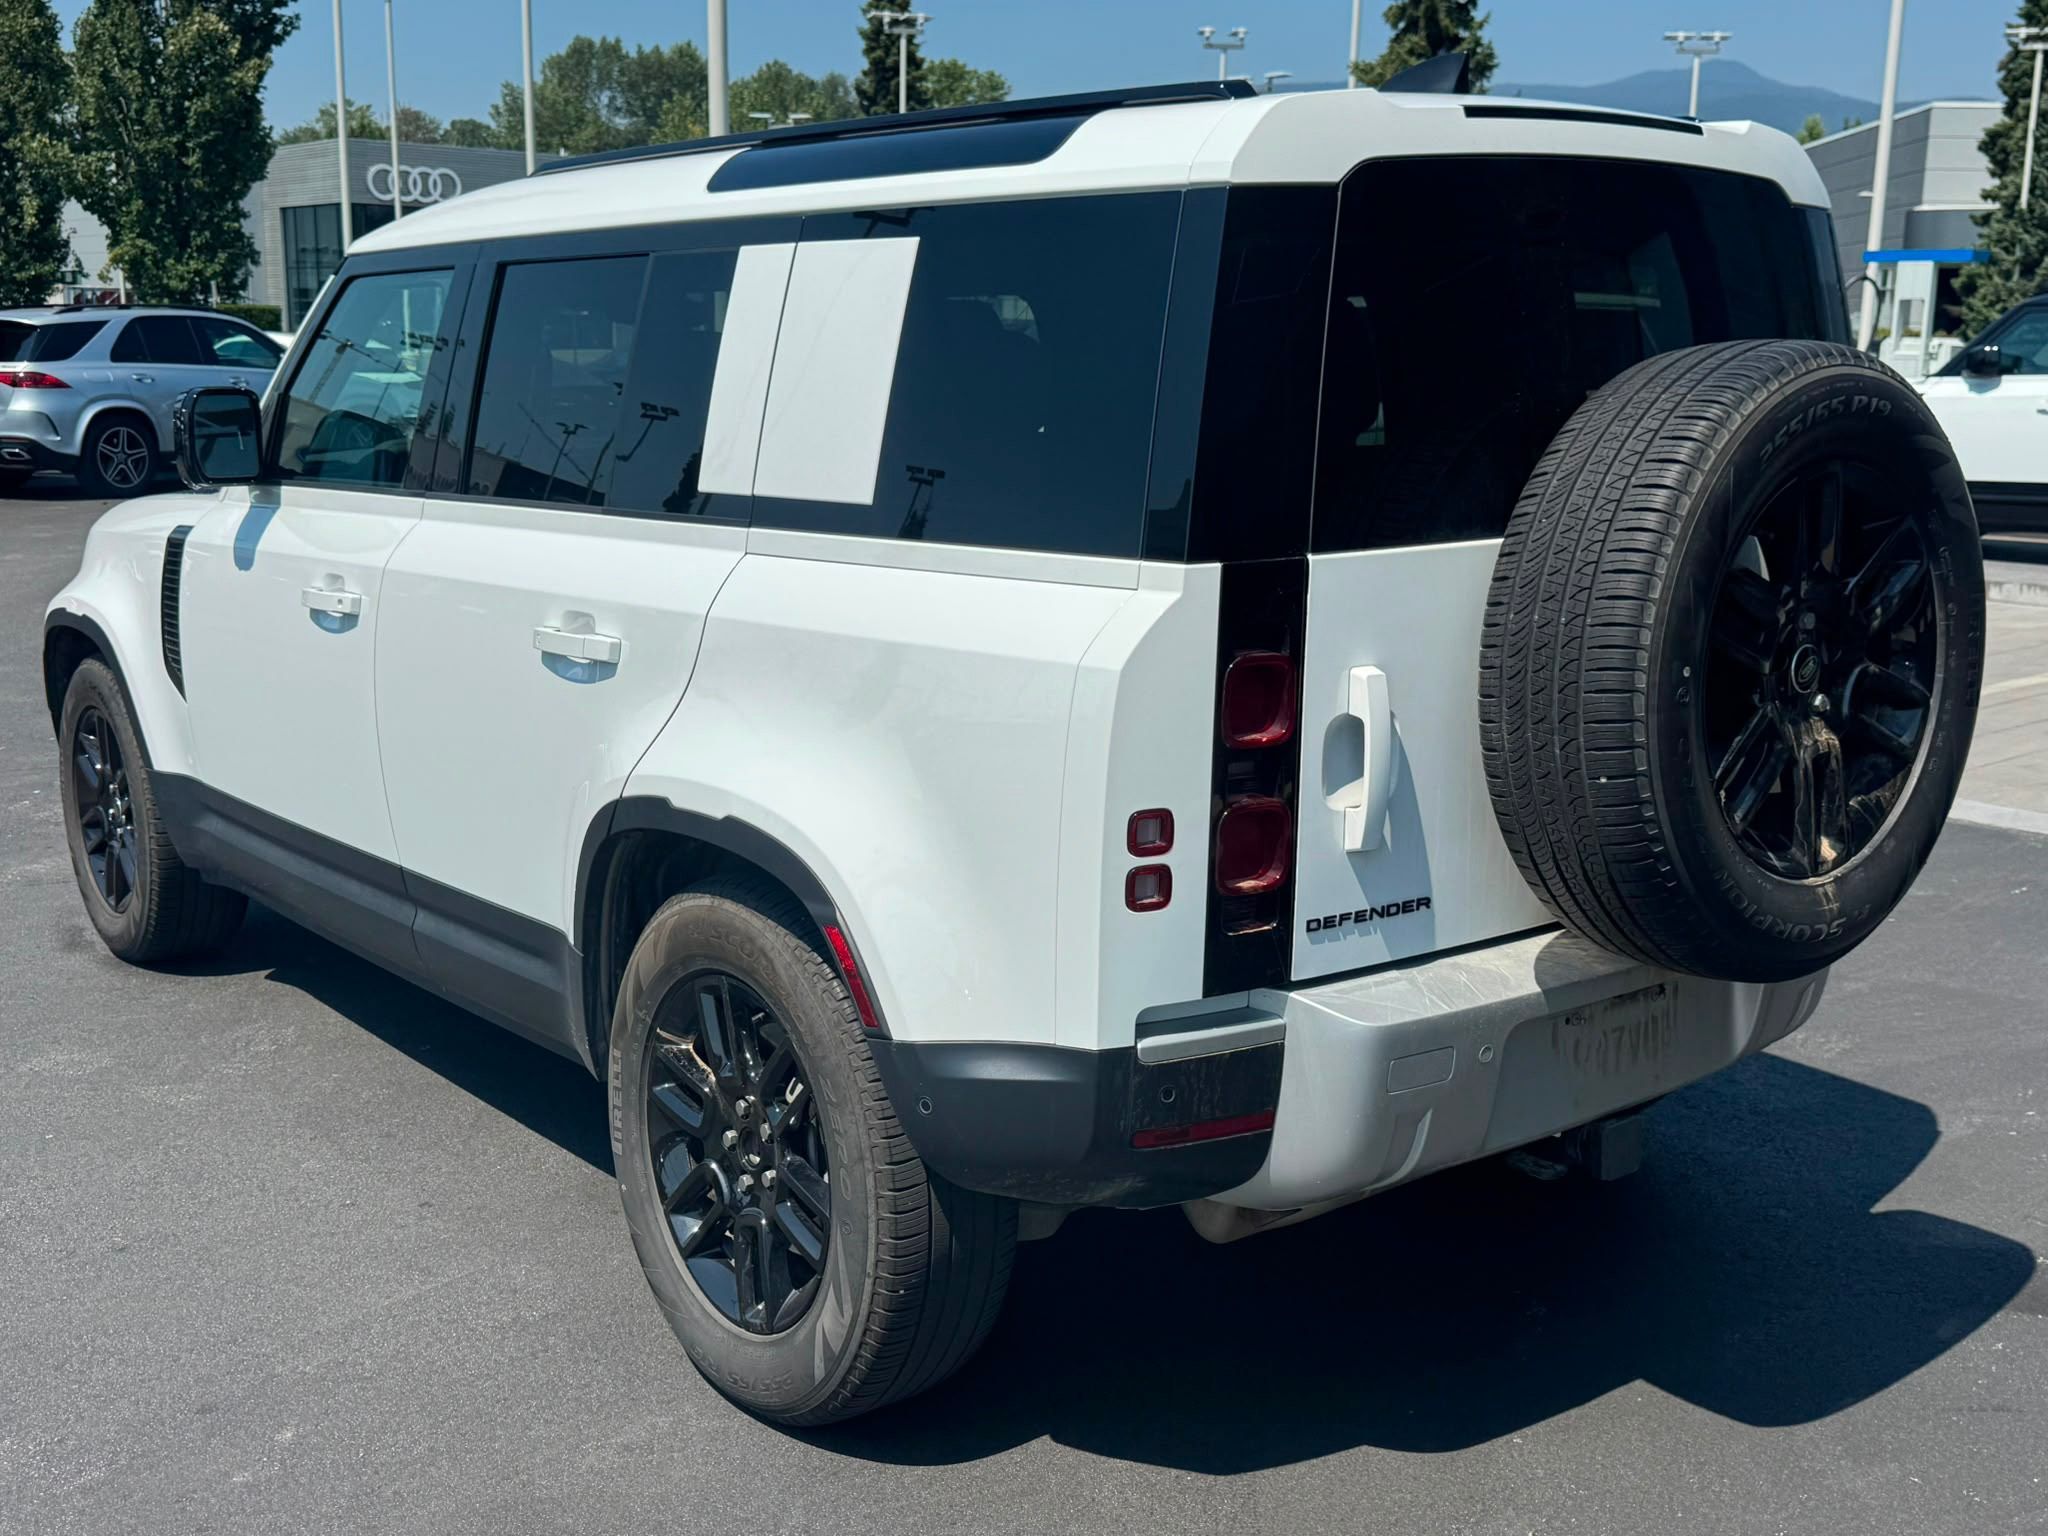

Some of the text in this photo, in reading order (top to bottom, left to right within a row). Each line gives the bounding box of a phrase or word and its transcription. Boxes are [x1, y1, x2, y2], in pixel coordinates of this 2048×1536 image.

[1305, 896, 1431, 933] DEFENDER
[1714, 870, 1847, 943] SCORPION
[818, 1074, 851, 1200] ZERO
